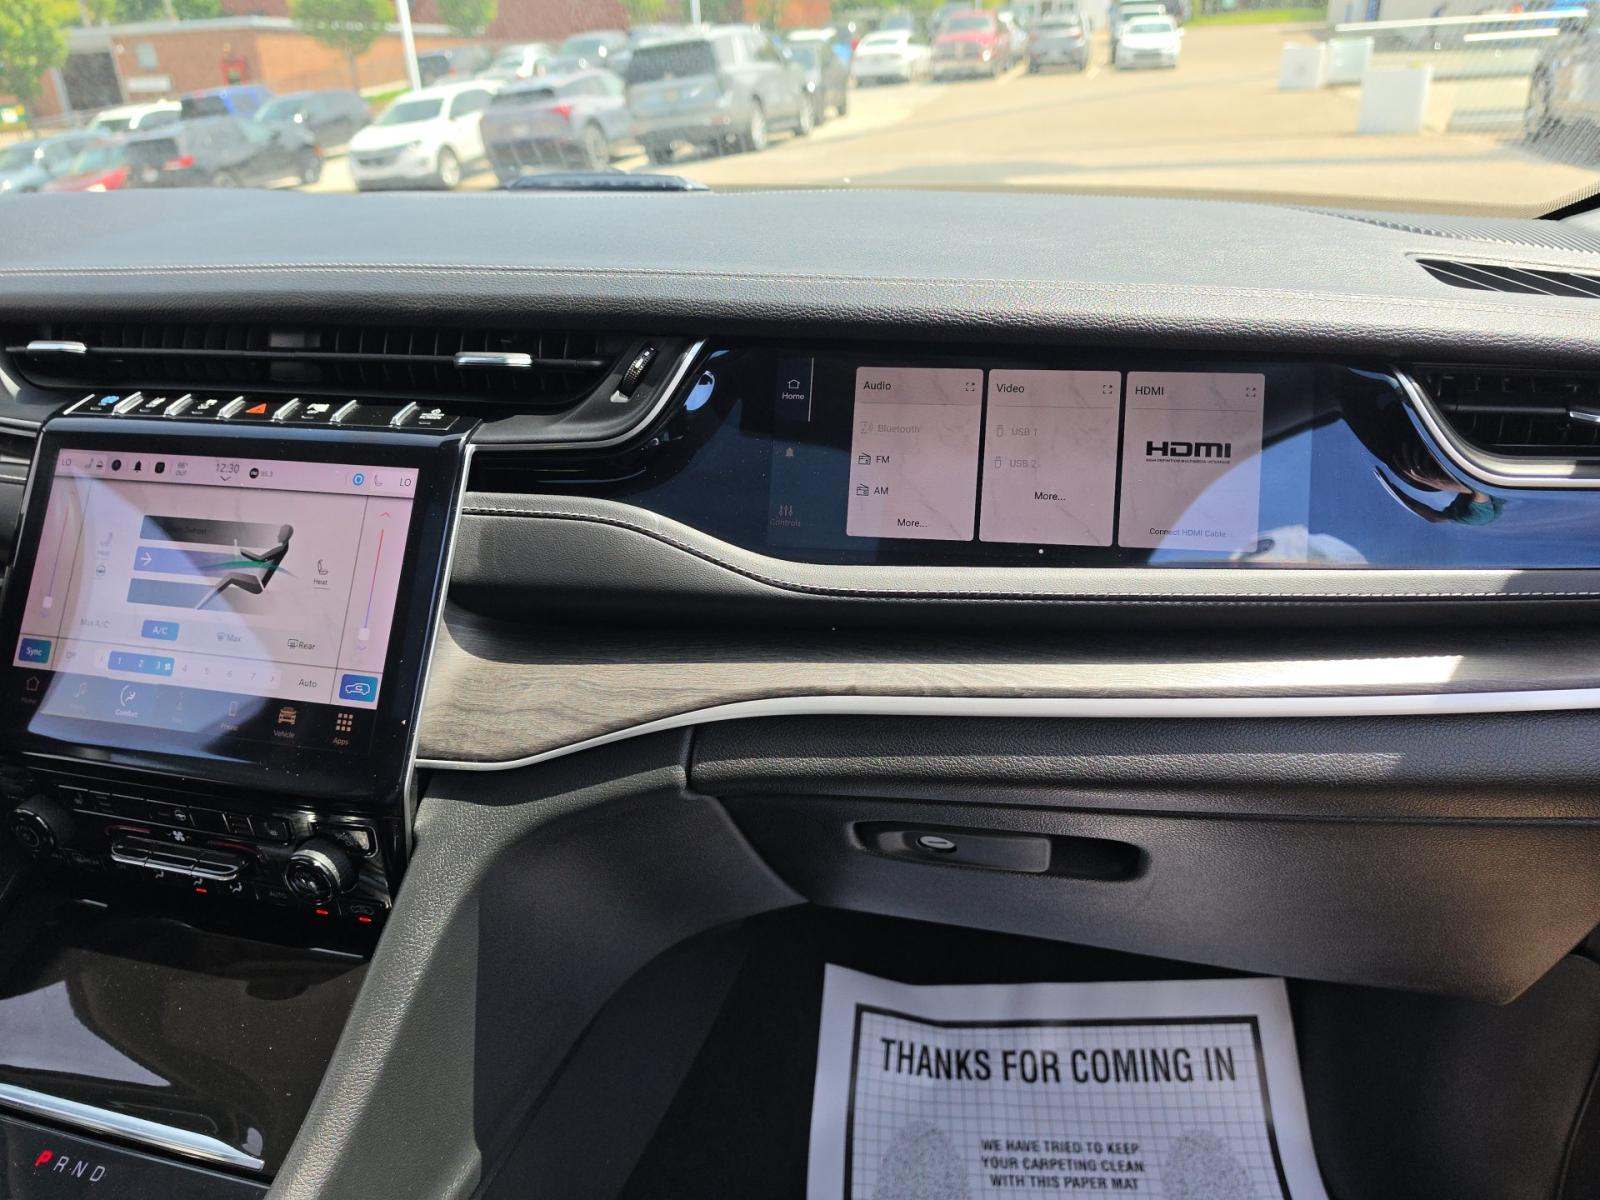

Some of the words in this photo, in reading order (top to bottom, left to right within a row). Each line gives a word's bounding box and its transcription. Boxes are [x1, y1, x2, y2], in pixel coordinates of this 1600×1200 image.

[863, 381, 892, 391] Audio
[996, 383, 1025, 393] Video
[1135, 386, 1164, 396] HDMI
[782, 392, 805, 400] Home
[877, 424, 920, 433] Bluetooth
[1011, 427, 1030, 436] USB
[1146, 441, 1231, 458] HDMI
[61, 458, 72, 467] LO
[876, 455, 890, 464] FM
[1009, 459, 1028, 468] USB
[216, 463, 240, 475] 12:30
[399, 477, 412, 487] LO
[873, 486, 889, 495] AM
[1034, 491, 1066, 501] More...
[769, 518, 801, 528] Controls
[897, 518, 928, 528] More...
[1149, 528, 1180, 536] Connect
[1182, 529, 1203, 537] HDMI
[1205, 530, 1226, 538] Cable
[313, 578, 328, 586] Heat
[152, 625, 168, 635] A/C
[226, 633, 241, 643] Max
[298, 641, 316, 650] Rear
[26, 647, 43, 657] Sync
[299, 678, 318, 688] Auto
[273, 729, 295, 738] Vehicle
[332, 737, 349, 746] Apps
[881, 1038, 992, 1081] THANKS
[1002, 1049, 1061, 1084] FOR
[1071, 1048, 1193, 1083] COMING
[1204, 1047, 1236, 1081] IN
[981, 1139, 1001, 1150] WE
[1006, 1140, 1037, 1151] HAVE
[1043, 1141, 1082, 1153] TRIED
[1086, 1142, 1103, 1154] TO
[1106, 1142, 1139, 1155] KEEP
[53, 1155, 70, 1173] R
[70, 1160, 89, 1178] N
[89, 1165, 106, 1182] D
[981, 1156, 1019, 1169] YOUR
[1022, 1157, 1097, 1171] CARPETING
[1100, 1159, 1144, 1172] CLEAN
[989, 1174, 1025, 1187] WITH
[1030, 1175, 1060, 1188] THIS
[1063, 1176, 1106, 1189] PAPER
[1110, 1177, 1139, 1190] MAT
